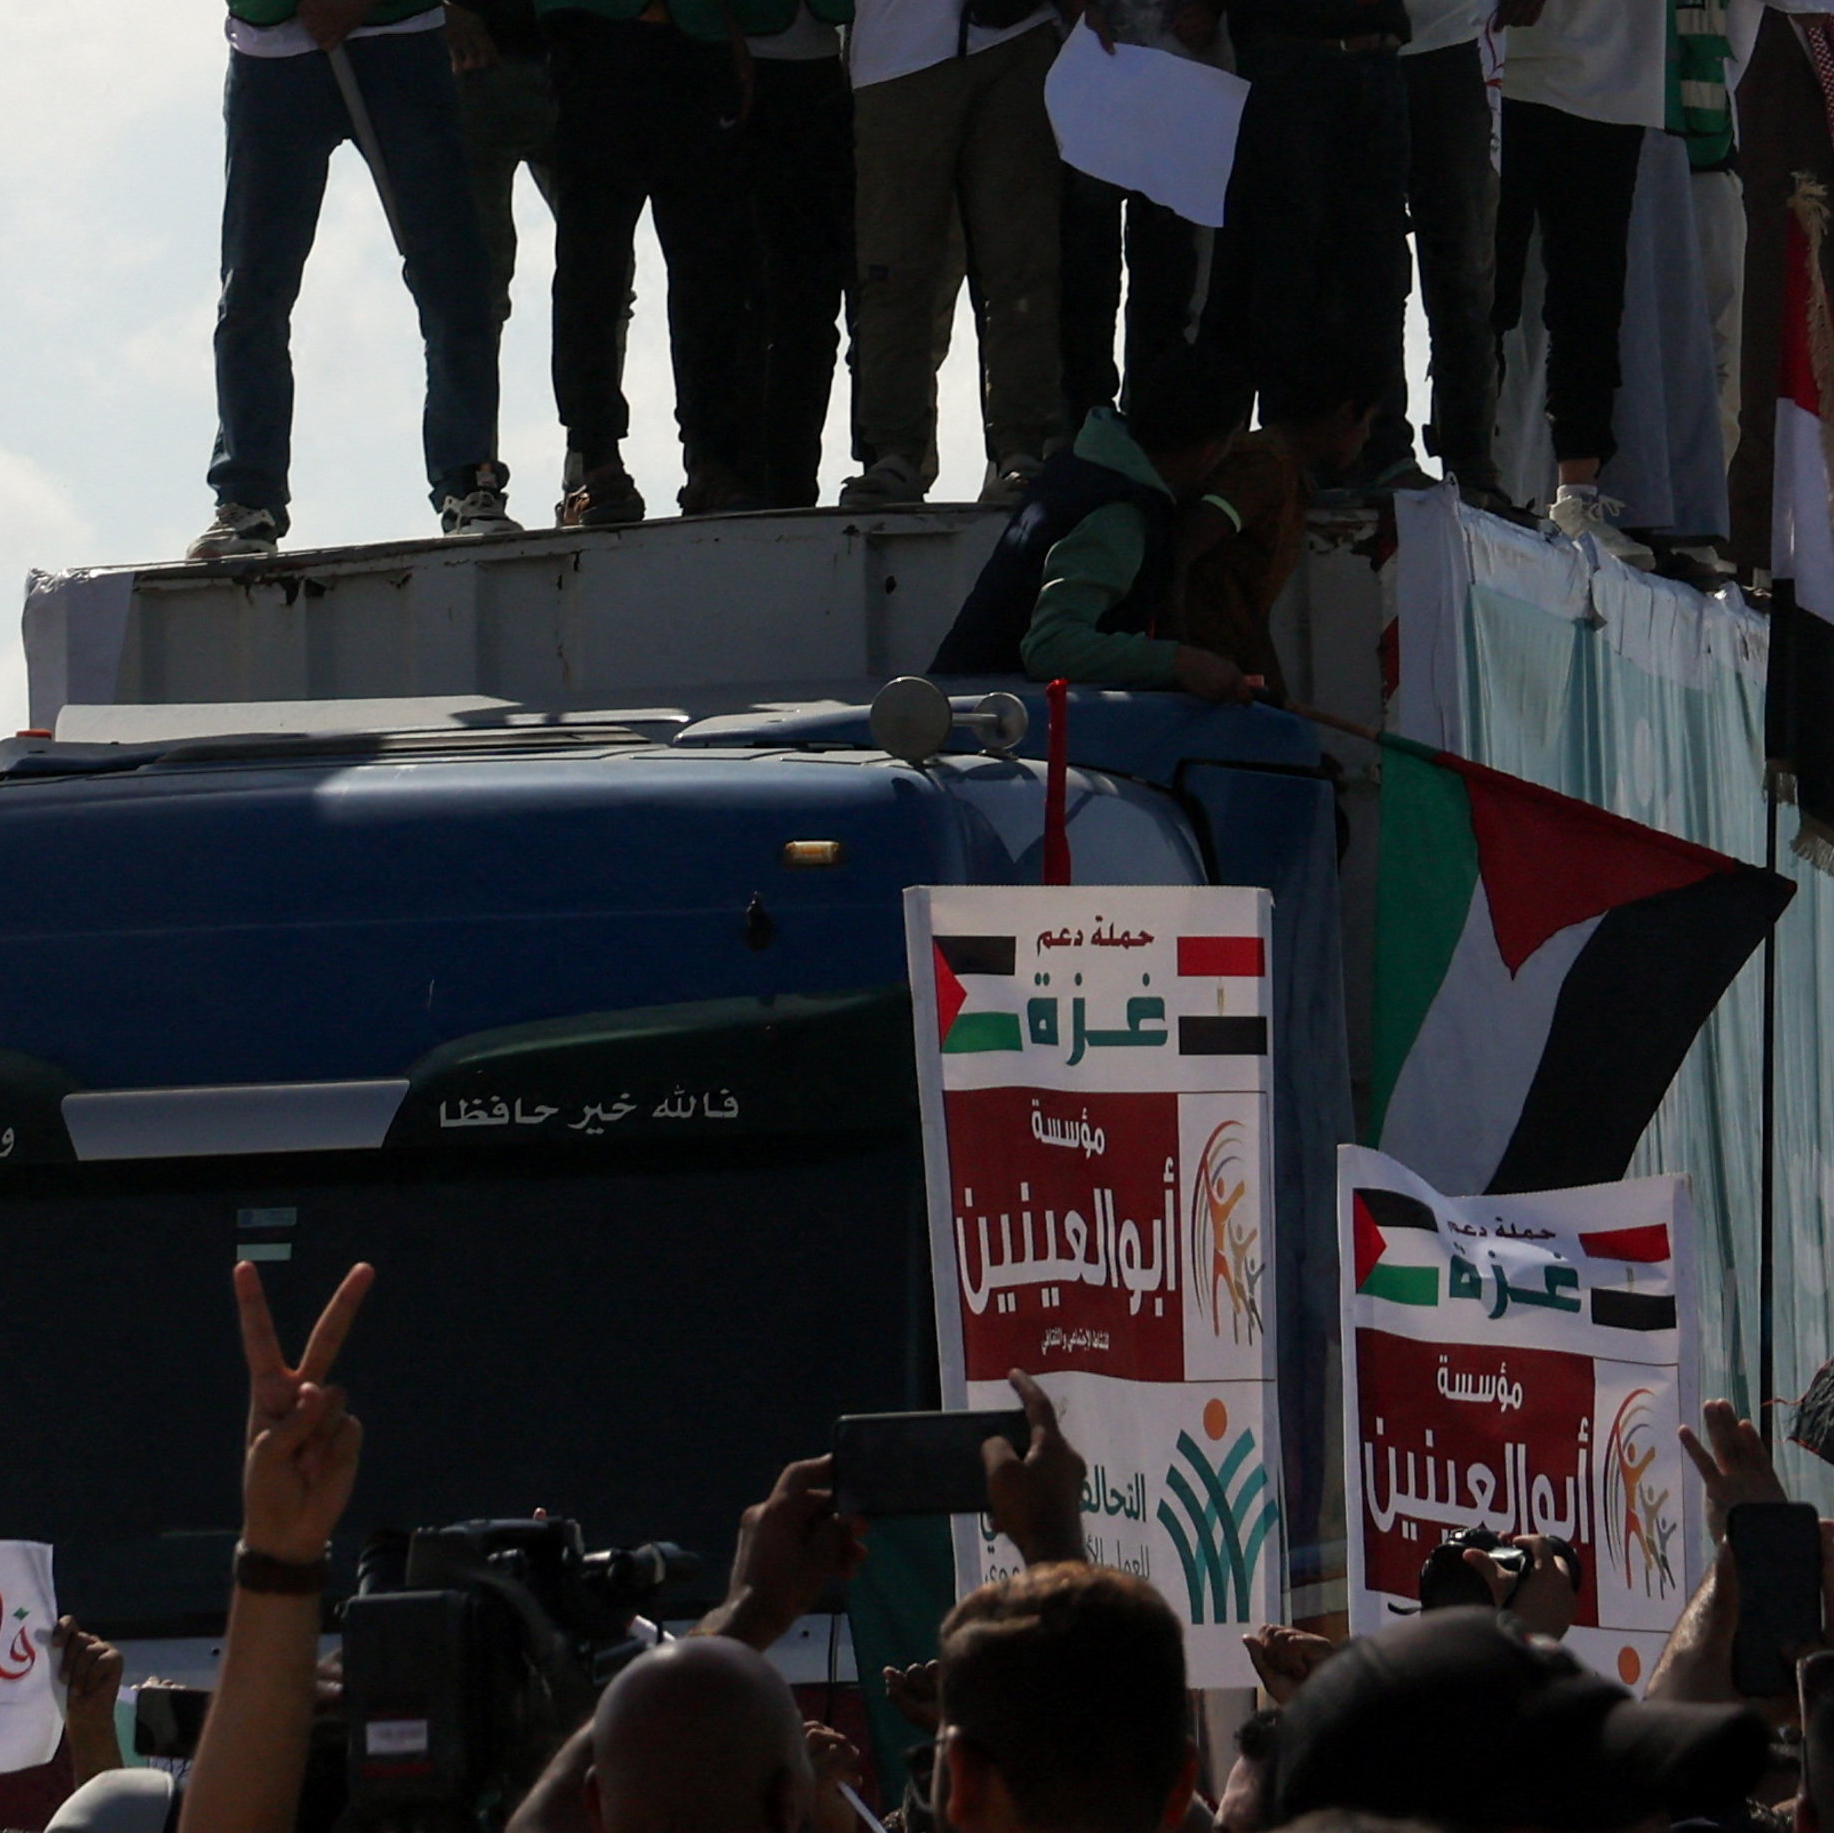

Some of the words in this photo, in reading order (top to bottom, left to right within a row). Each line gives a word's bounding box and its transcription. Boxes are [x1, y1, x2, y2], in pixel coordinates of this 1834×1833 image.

[1036, 923, 1084, 956] دعم
[1090, 916, 1155, 948] حملة
[1026, 972, 1168, 1066] غزة
[439, 1095, 559, 1128] حافظا
[568, 1092, 638, 1135] خير
[651, 1083, 739, 1120] فالله
[1031, 1099, 1106, 1159] مؤسسة
[1448, 1221, 1487, 1237] دعم
[1496, 1217, 1556, 1239] حملة
[1449, 1241, 1582, 1320] غزة
[1437, 1355, 1523, 1414] مؤسسة
